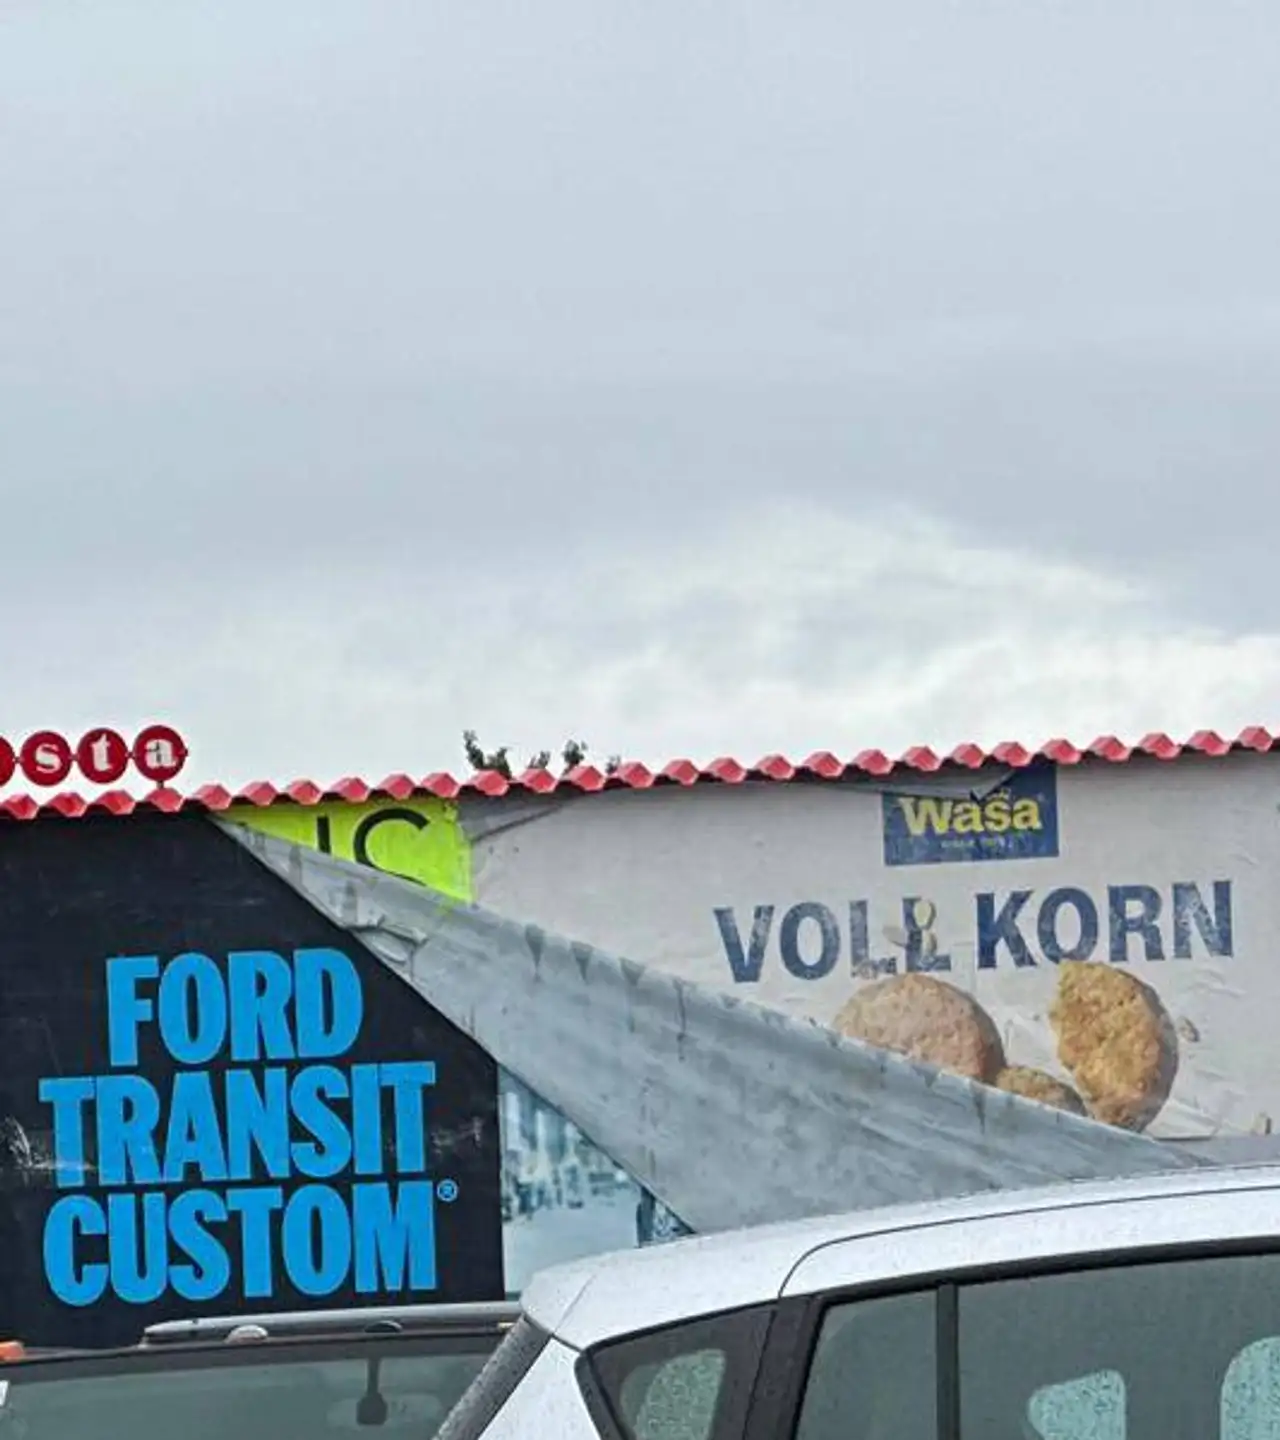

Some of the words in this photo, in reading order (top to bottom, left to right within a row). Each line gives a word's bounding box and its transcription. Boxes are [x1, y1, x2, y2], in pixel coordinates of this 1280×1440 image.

[898, 788, 1043, 837] Wasa
[713, 896, 950, 984] VOLL
[974, 880, 1234, 971] KORN
[106, 948, 363, 1067] FORD
[39, 1061, 436, 1188] TRANSIT
